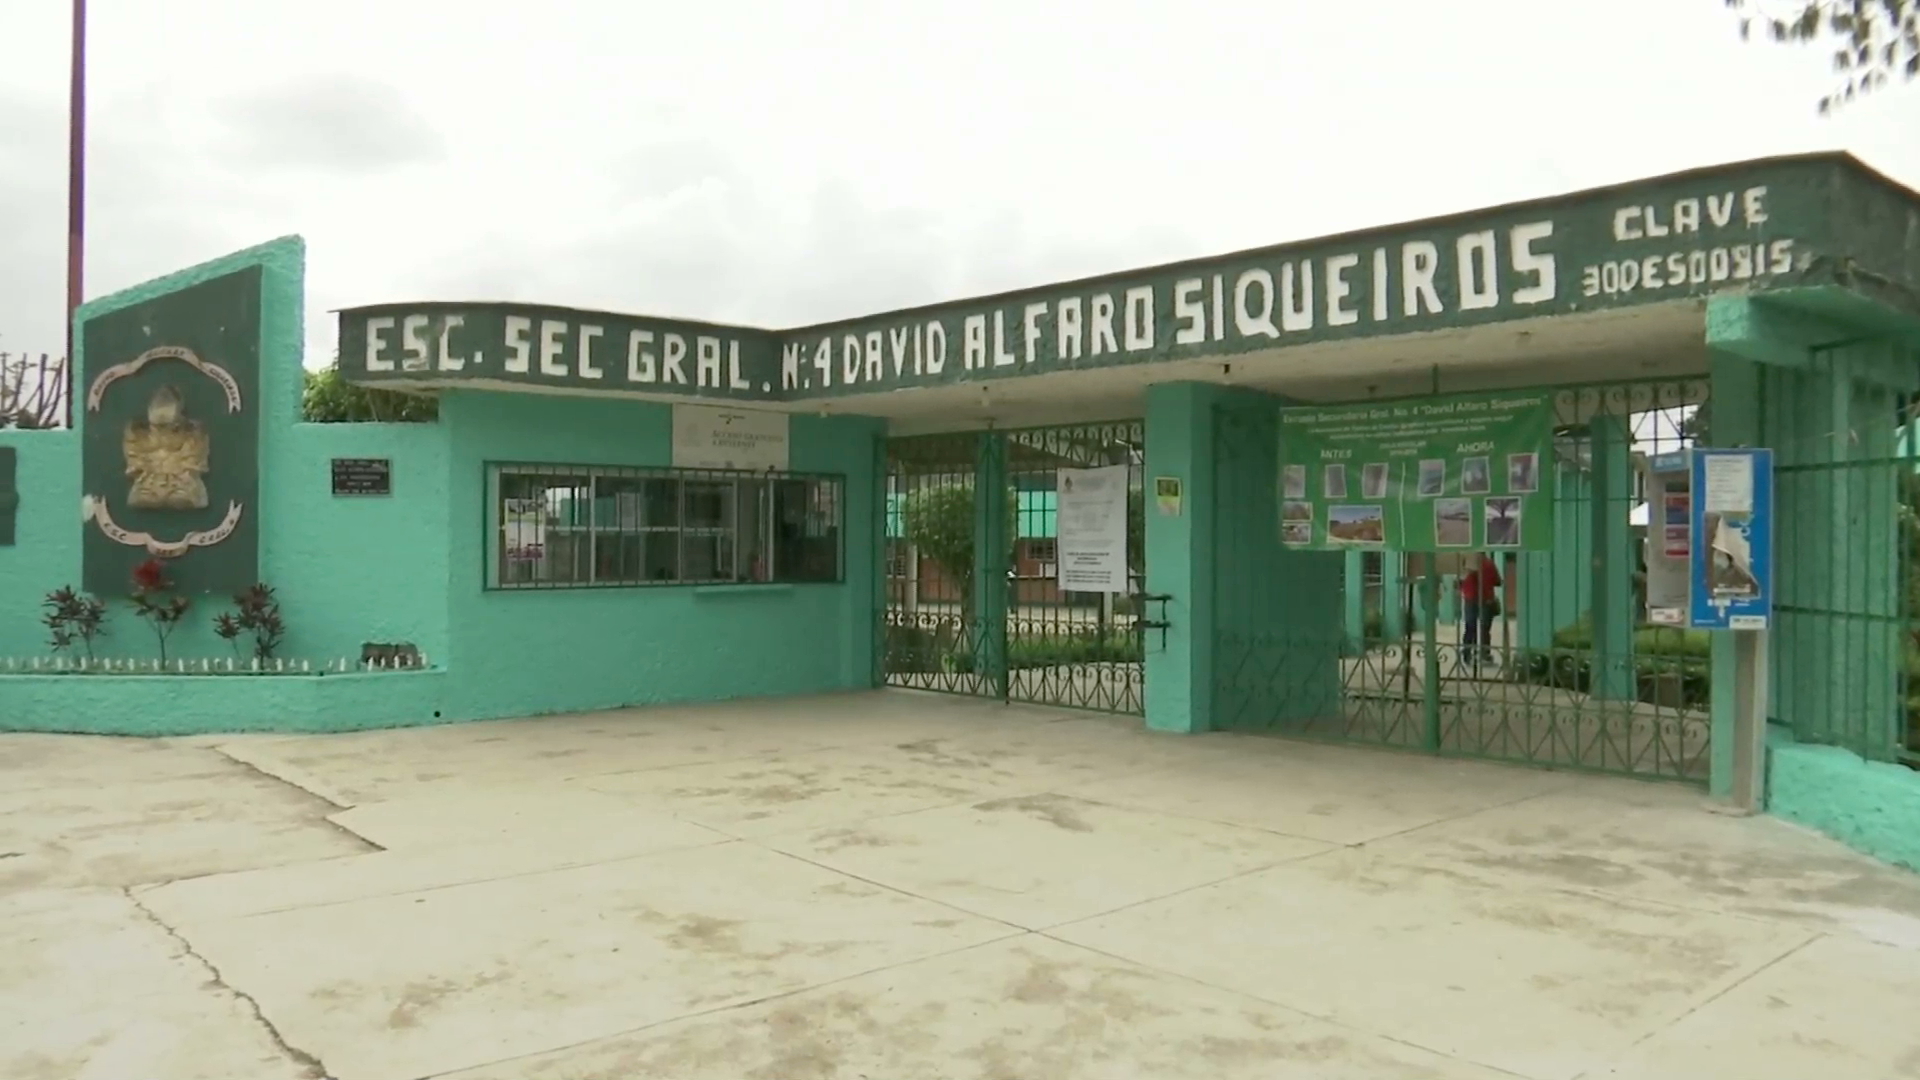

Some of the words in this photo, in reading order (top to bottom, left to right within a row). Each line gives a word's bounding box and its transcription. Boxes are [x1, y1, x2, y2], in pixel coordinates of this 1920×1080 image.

[1613, 186, 1769, 242] CLAVE
[366, 314, 483, 372] ESC.
[504, 316, 604, 380] SEC
[843, 319, 946, 385] DAVID
[964, 284, 1155, 371] ALFARO
[1174, 219, 1556, 345] SIQUEIROS
[1320, 449, 1352, 459] ANTES
[1456, 441, 1494, 453] AHORA
